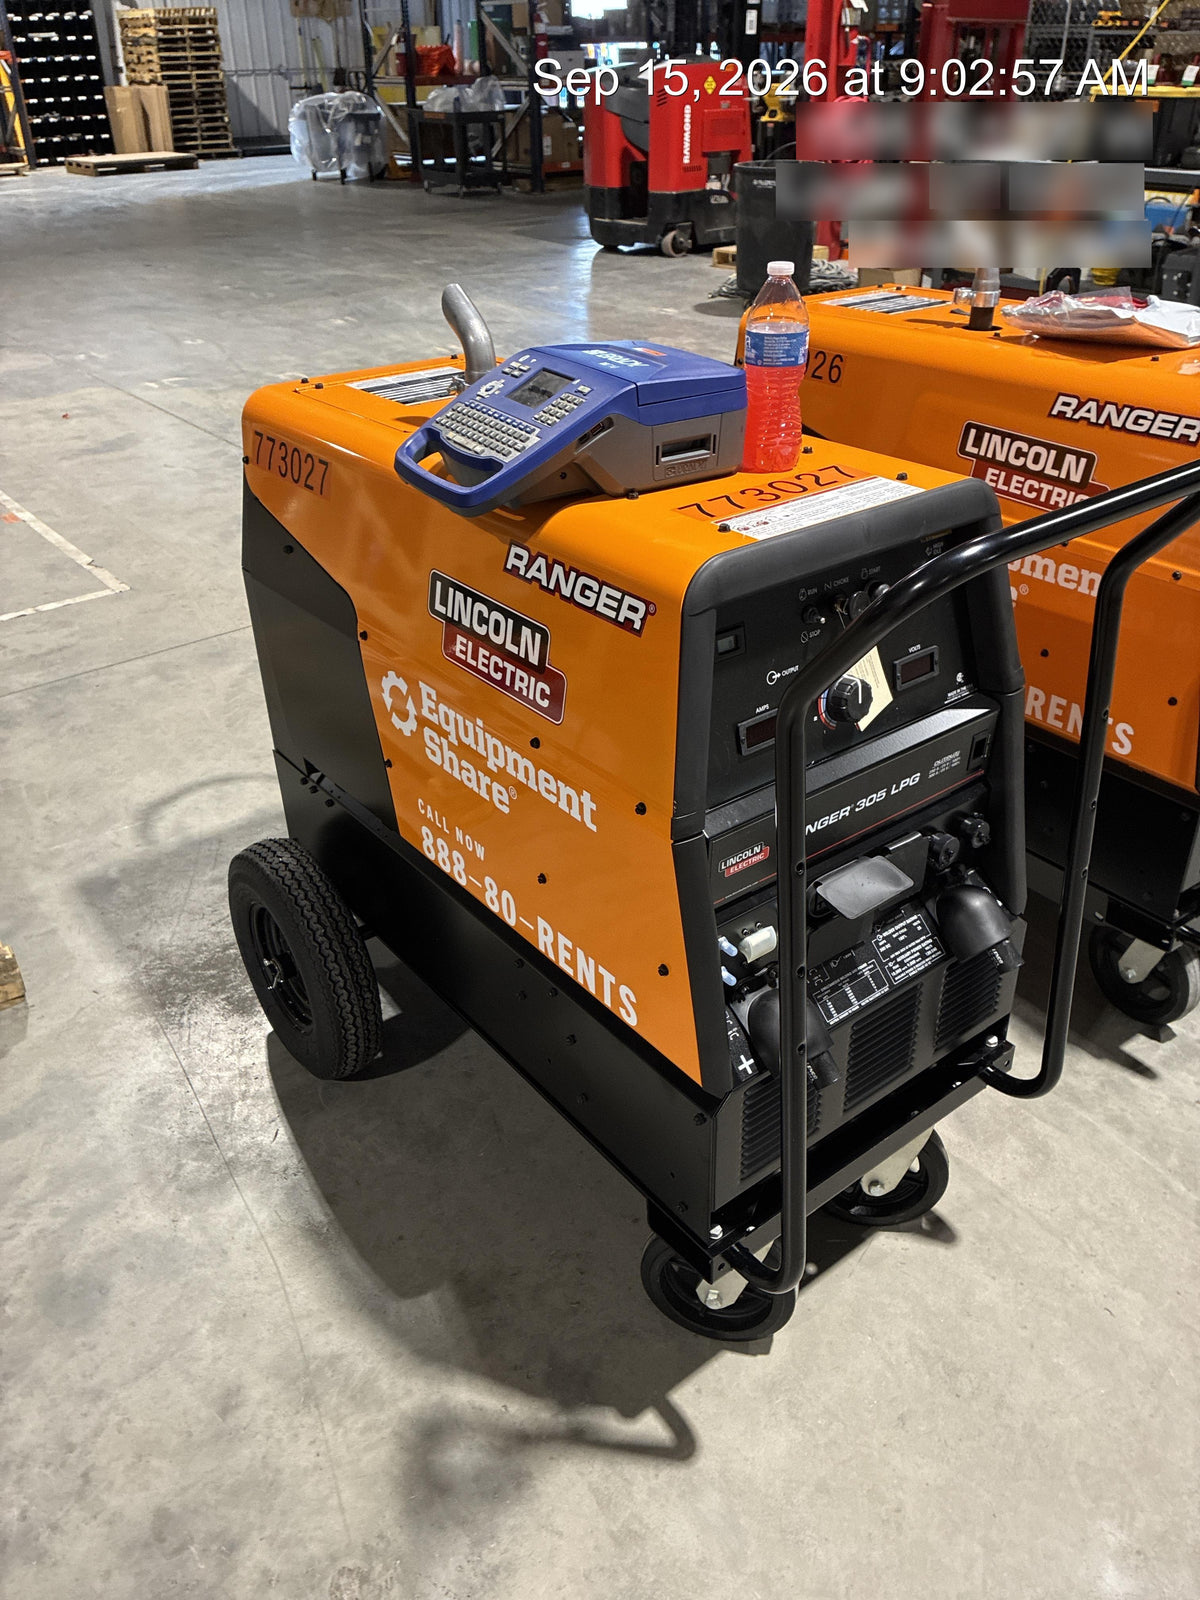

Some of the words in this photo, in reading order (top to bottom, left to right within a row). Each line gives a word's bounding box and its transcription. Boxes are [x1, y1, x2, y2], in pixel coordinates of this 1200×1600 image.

[682, 104, 692, 164] RAYMOND
[1050, 394, 1200, 443] RANGER
[254, 430, 330, 496] 773027
[965, 428, 1088, 484] LINCOLN
[677, 464, 856, 518] 773027
[433, 579, 543, 667] LINCOLN
[454, 633, 552, 709] ELECTRIC
[781, 664, 800, 677] OUTPUT
[755, 703, 770, 715] AMPS
[418, 680, 598, 833] Equipment
[855, 787, 888, 813] 305
[890, 772, 921, 796] LPG
[418, 798, 450, 835] CALL
[455, 826, 486, 862] NOW
[721, 844, 761, 870] LINCOLN
[729, 852, 765, 874] ELECTRIC
[420, 825, 639, 1027] 888-80-RENTS
